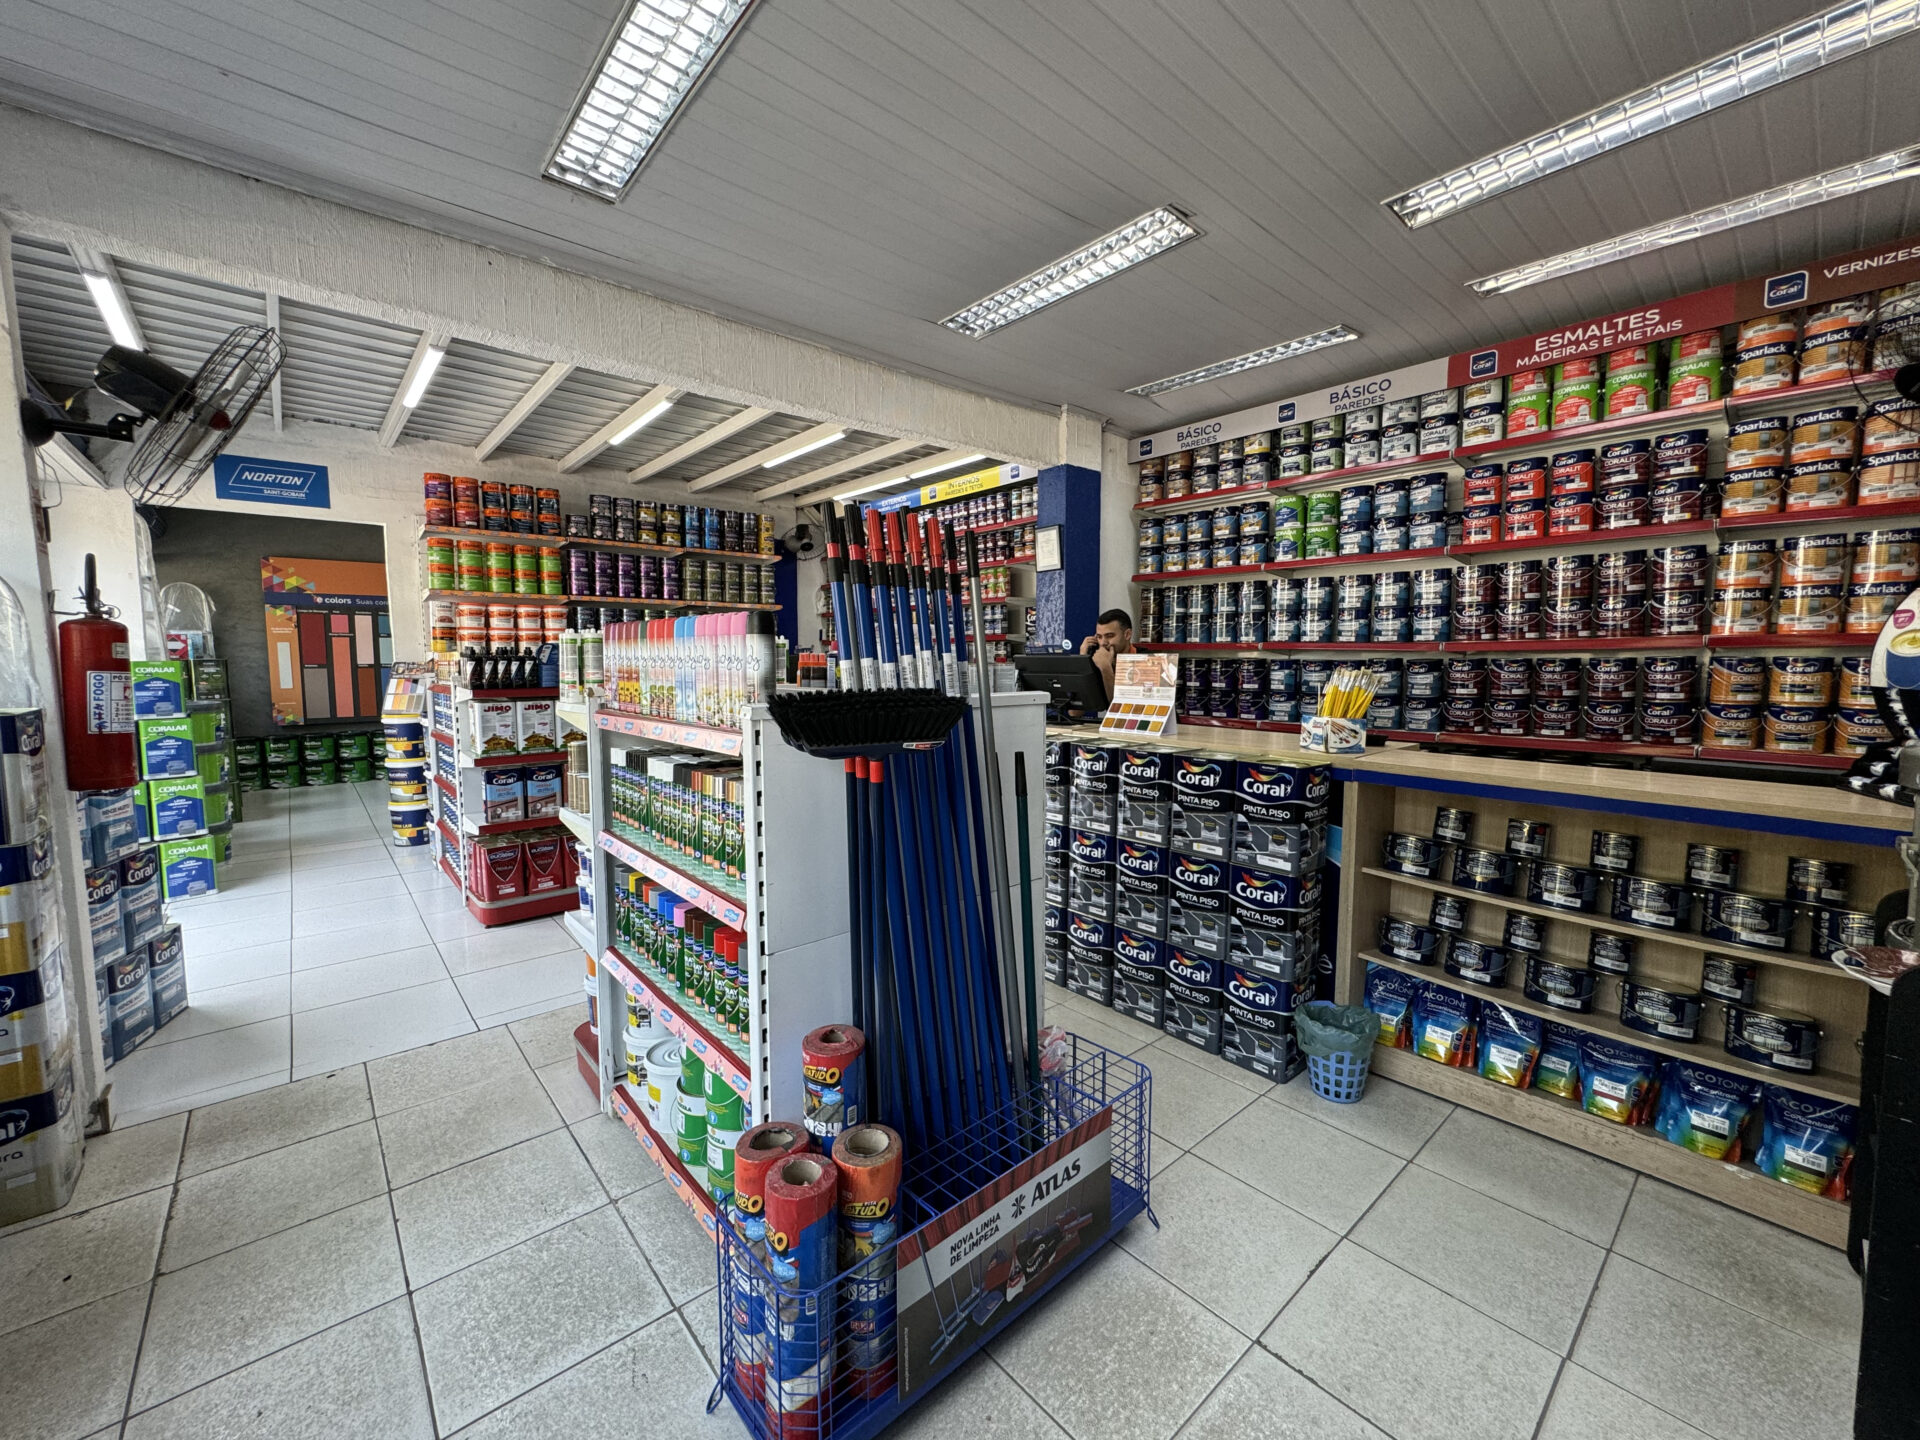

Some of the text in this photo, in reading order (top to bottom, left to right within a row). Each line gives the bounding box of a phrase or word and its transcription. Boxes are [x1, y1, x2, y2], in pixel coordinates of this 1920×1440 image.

[1824, 246, 1920, 279] VERNIZES
[1769, 284, 1799, 298] Coral
[1535, 309, 1660, 351] ESMALTES
[1516, 320, 1683, 368] MADEIRAS E METAIS
[1804, 330, 1851, 349] Sparlack
[1740, 344, 1786, 361] Sparlack
[1473, 360, 1493, 370] Coral
[1673, 361, 1710, 374] CORALAR
[1612, 372, 1647, 384] CORALAR
[1329, 378, 1392, 404] BÁSICO
[1557, 383, 1590, 394] CORALAR
[1334, 394, 1385, 413] PAREDES
[1509, 395, 1536, 406] CORALAR
[1469, 408, 1488, 419] Coral
[1796, 410, 1843, 426] Sparlack
[1177, 422, 1222, 442] BÁSICO
[1735, 420, 1781, 434] Sparlack
[1180, 434, 1218, 450] PAREDES
[1660, 438, 1686, 449] Coral
[1607, 448, 1631, 458] Coral
[1657, 447, 1693, 458] CORALIT
[1868, 450, 1920, 466] Sparlack
[1555, 457, 1576, 467] Coral
[1604, 456, 1637, 466] CORALIT
[1794, 461, 1841, 475] Sparlack
[1553, 465, 1581, 475] CORALIT
[1729, 469, 1775, 482] Sparlack
[241, 471, 304, 486] NORTON
[948, 476, 980, 489] INTERNOS
[263, 489, 306, 498] SAINT-GOBAIN
[1554, 498, 1576, 507] Coral
[1719, 590, 1761, 600] Sparlack
[1783, 587, 1831, 598] Sparlack
[1854, 584, 1906, 595] Sparlack
[325, 596, 352, 605] colors
[1664, 598, 1689, 606] Coral
[1786, 665, 1813, 673] Coral
[93, 674, 104, 701] FOGO
[524, 703, 551, 711] JIMO
[1647, 707, 1671, 716] Coral
[1780, 713, 1808, 722] Coral
[1074, 756, 1103, 772] Coral
[1122, 760, 1155, 778] Coral
[493, 777, 515, 785] Coral
[533, 773, 553, 781] Coral
[1074, 778, 1108, 790] PINTA PISO
[1177, 767, 1215, 787] Coral
[158, 784, 198, 793] CORALAR
[1122, 785, 1160, 797] PINTA PISO
[1243, 777, 1285, 798] Coral
[1306, 778, 1327, 799] Coral
[1178, 795, 1220, 808] PINTA PISO
[1243, 804, 1291, 819] PINTA PISO
[168, 844, 208, 855] CORALAR
[1072, 842, 1101, 858] Coral
[1120, 851, 1153, 871] Coral
[127, 863, 154, 882] Coral
[1072, 863, 1106, 876] PINTA PISO
[1176, 866, 1214, 886] Coral
[1120, 875, 1158, 890] PINTA PISO
[87, 881, 115, 902] Coral
[1176, 890, 1219, 907] PINTA PISO
[1236, 881, 1278, 903] Coral
[1236, 907, 1285, 926] PINTA PISO
[1070, 925, 1099, 943] Coral
[155, 944, 180, 963] Coral
[1070, 945, 1103, 960] PINTA PISO
[1117, 941, 1150, 962] Coral
[116, 966, 145, 988] Coral
[1118, 963, 1155, 981] PINTA PISO
[1169, 959, 1206, 983] Coral
[1169, 982, 1210, 1003] PINTA PISO
[1228, 983, 1270, 1007] Coral
[1423, 991, 1467, 1008] ACOTONE
[1229, 1005, 1275, 1028] PINTA PISO
[1744, 1016, 1787, 1031] HAMMERITE
[1031, 1158, 1080, 1207] ATLAS
[950, 1212, 1001, 1253] NOVA LINHA
[950, 1226, 1000, 1266] DE LIMPEZA
